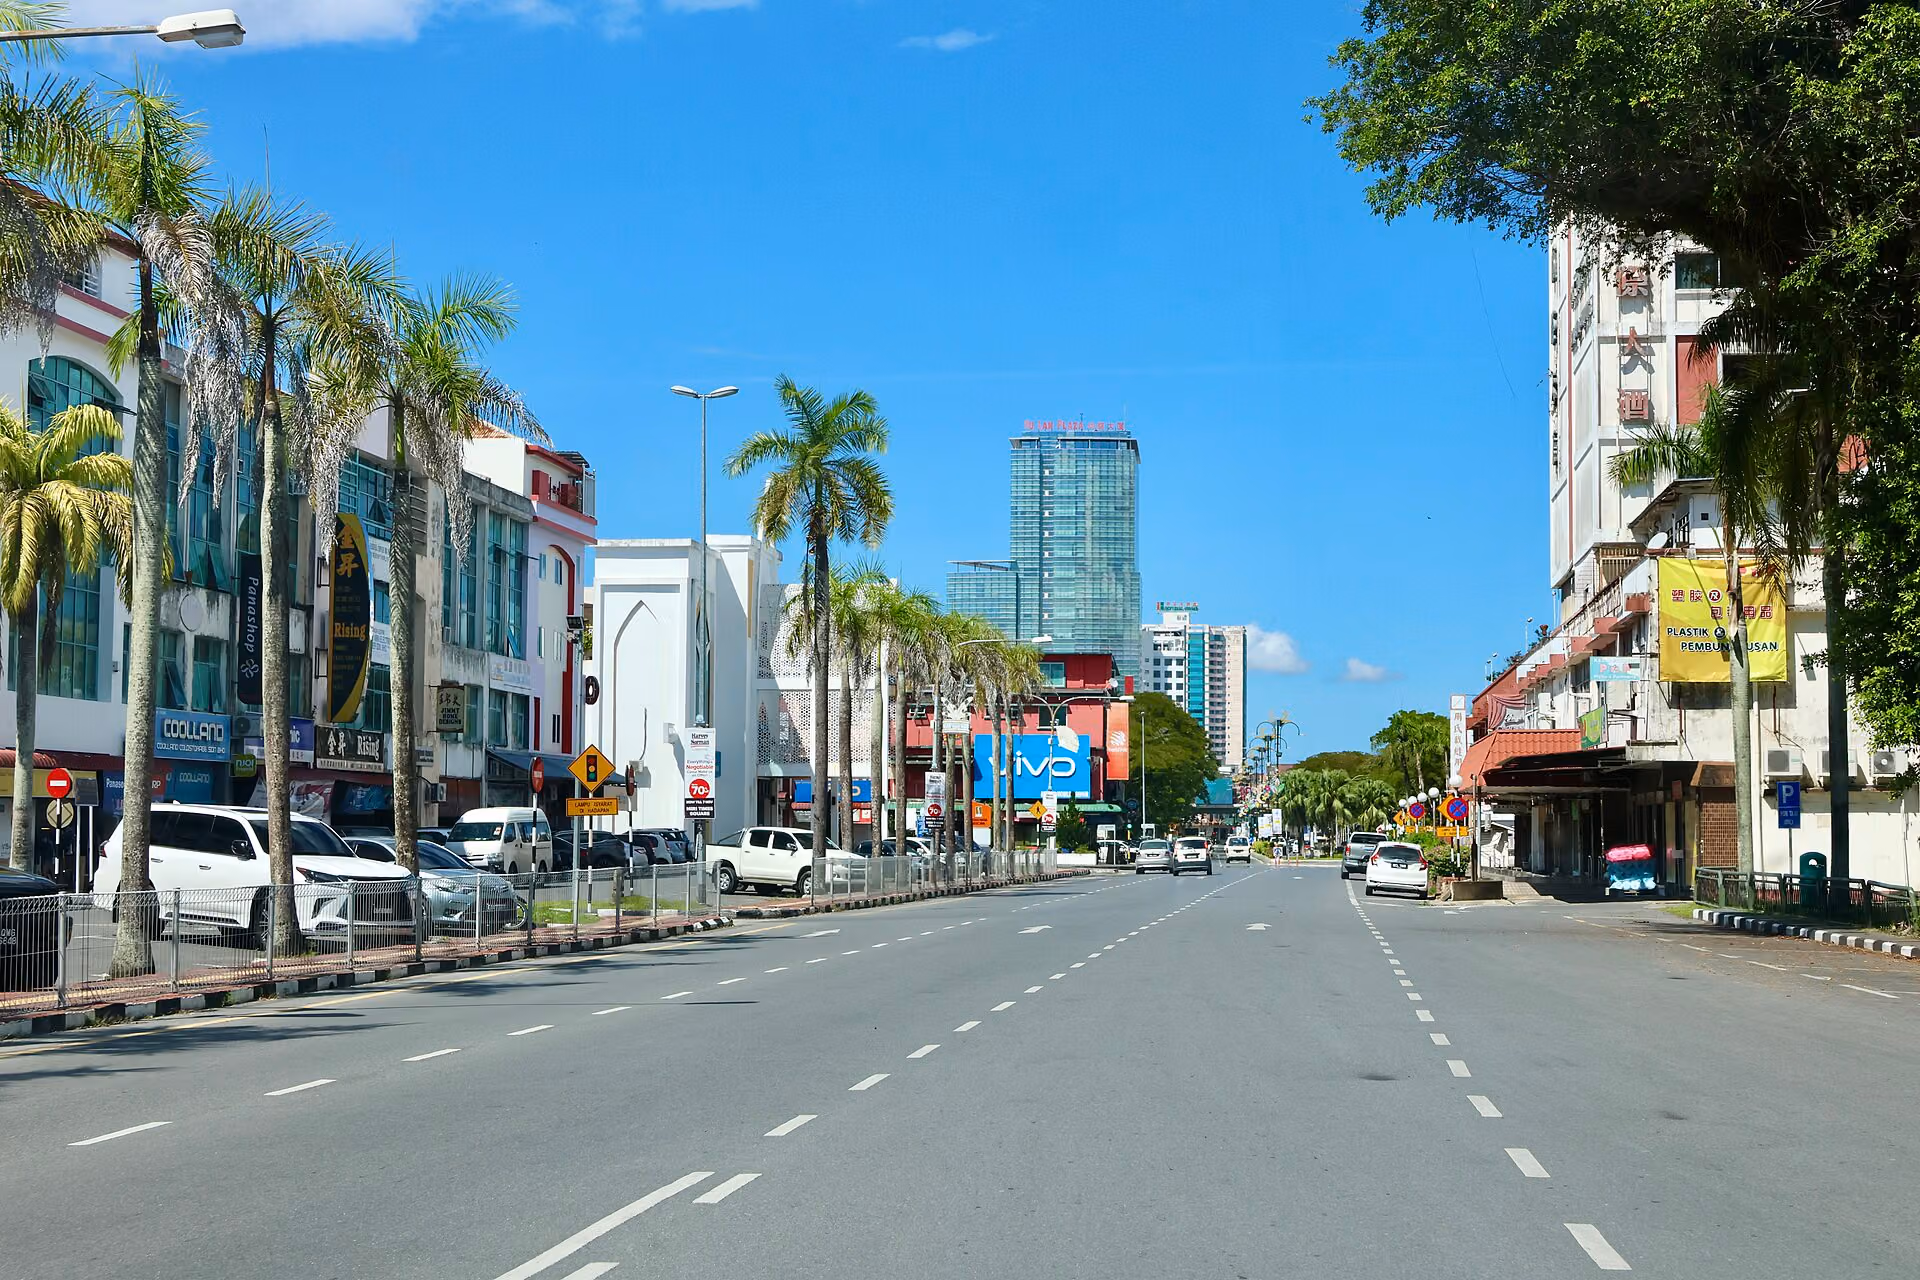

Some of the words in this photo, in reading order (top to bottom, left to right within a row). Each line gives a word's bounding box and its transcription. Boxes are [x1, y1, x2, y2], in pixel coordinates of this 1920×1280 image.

[1057, 419, 1083, 430] PLAZA
[244, 577, 259, 652] Panashop
[1710, 605, 1773, 619] 包用品
[334, 622, 367, 641] Rising
[1667, 627, 1709, 637] PLASTIK
[1681, 641, 1779, 652] PEMBUNUSAN
[163, 718, 224, 742] COOLLAND
[357, 735, 379, 761] Rising
[1782, 785, 1794, 803] P
